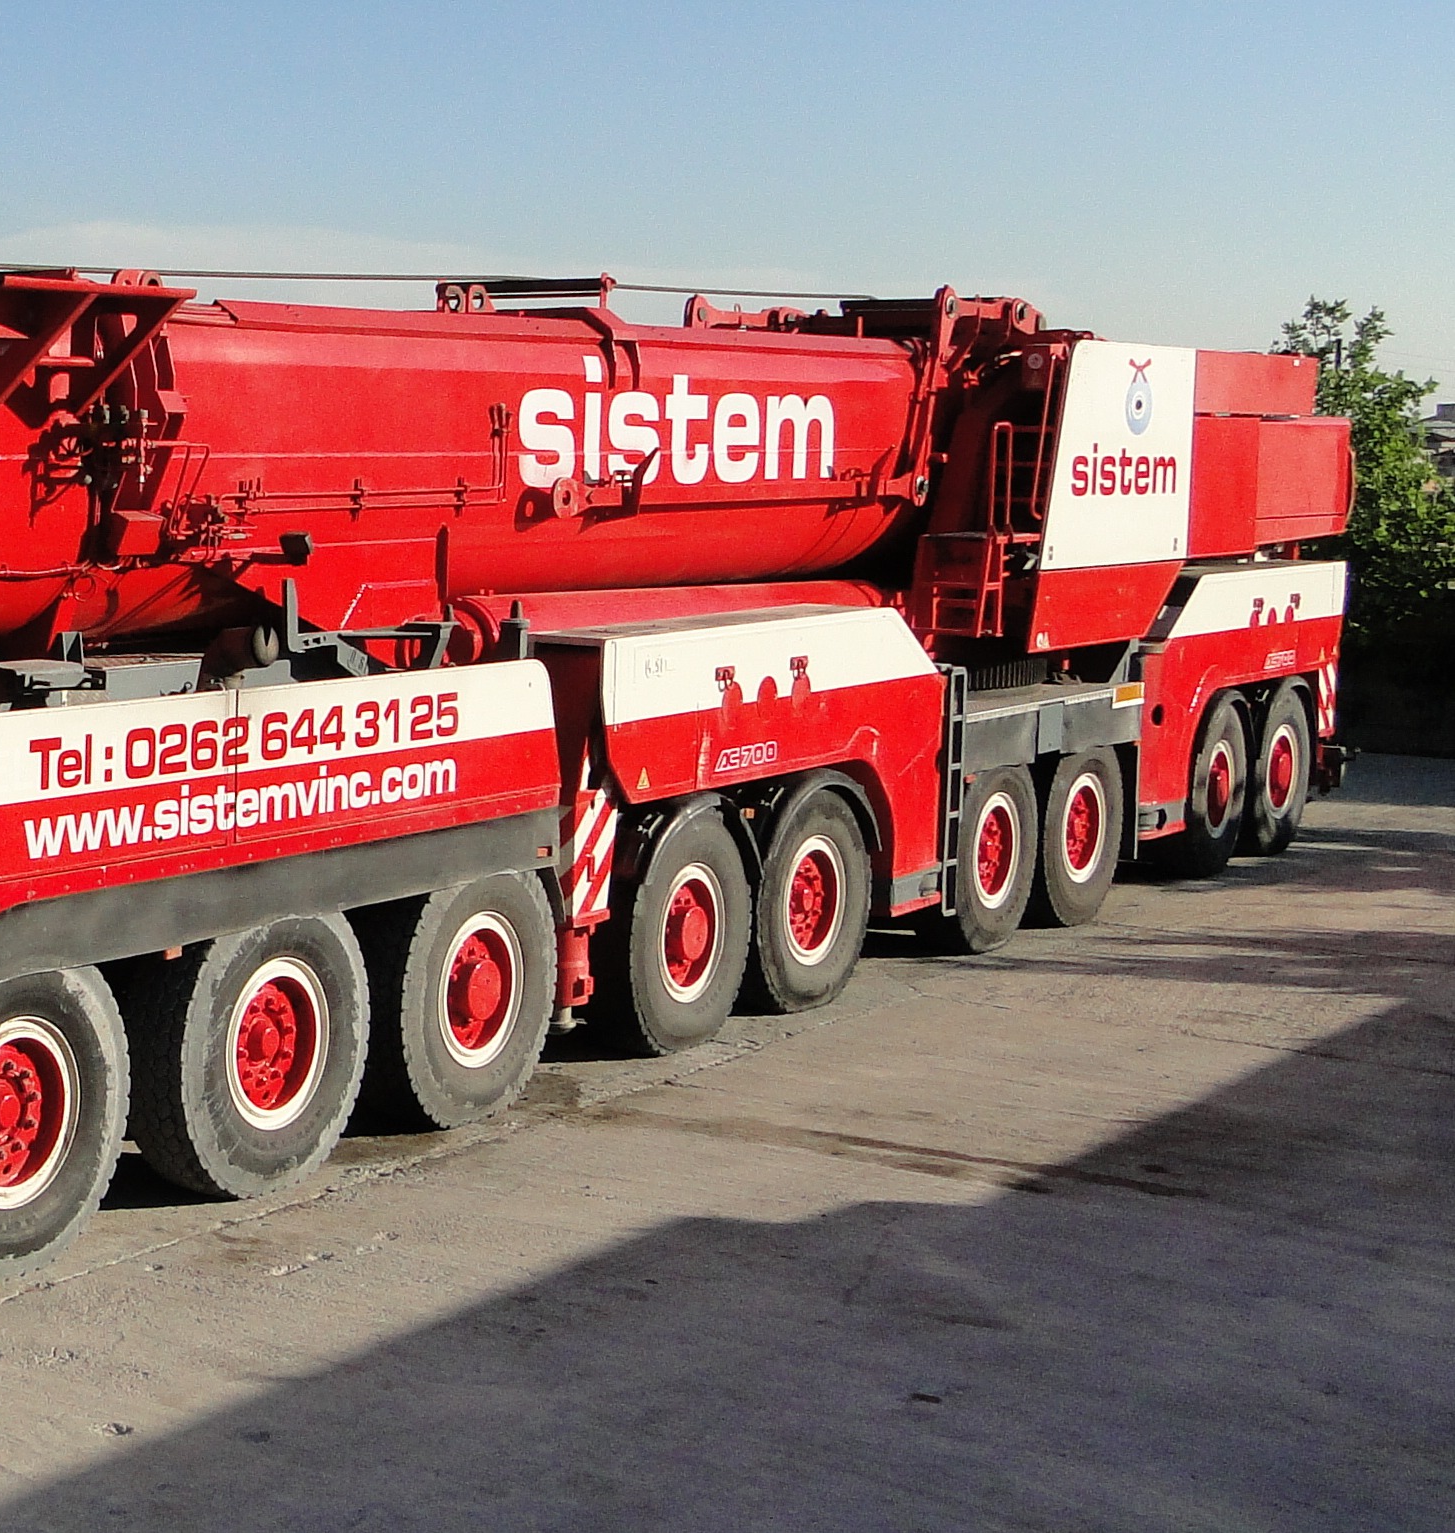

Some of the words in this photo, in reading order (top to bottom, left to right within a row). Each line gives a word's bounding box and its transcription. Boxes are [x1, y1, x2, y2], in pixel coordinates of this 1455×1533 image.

[518, 355, 835, 486] sistem
[1071, 443, 1177, 497] sistem
[125, 714, 251, 780] 0262
[261, 705, 347, 762] 644
[24, 757, 458, 860] www.sistemvinc.com
